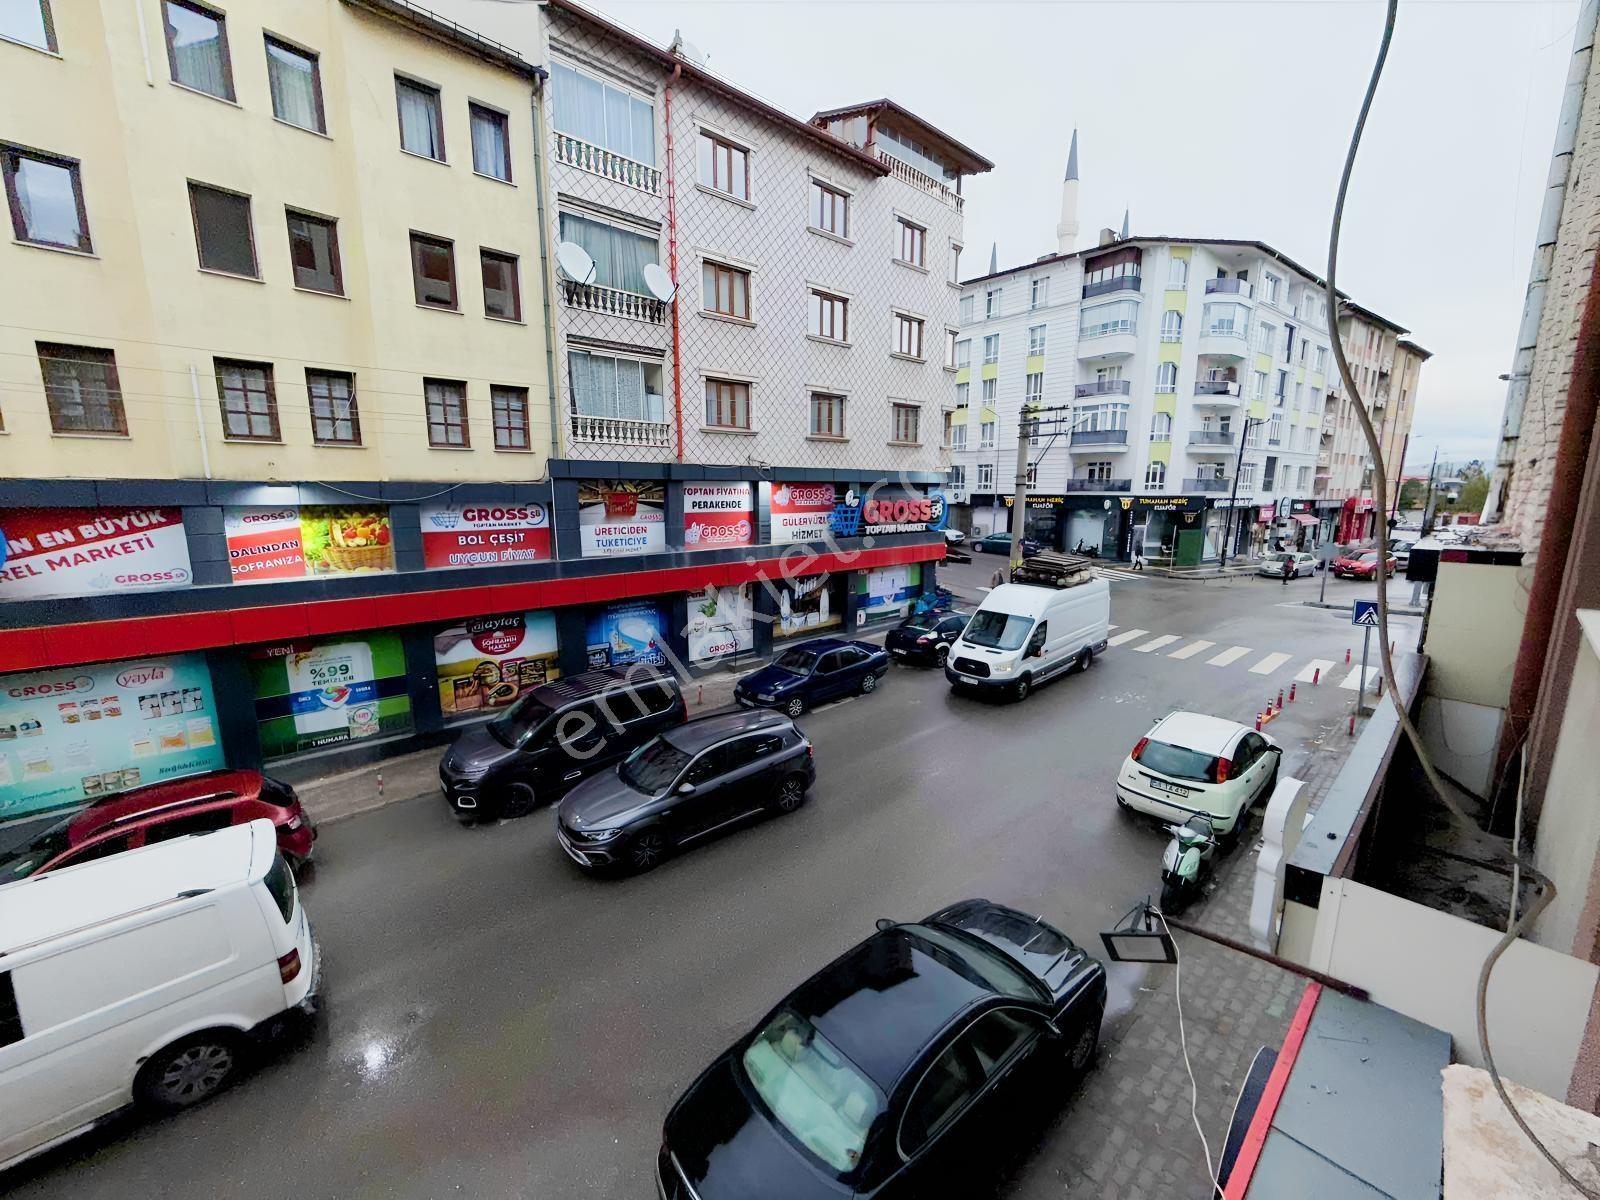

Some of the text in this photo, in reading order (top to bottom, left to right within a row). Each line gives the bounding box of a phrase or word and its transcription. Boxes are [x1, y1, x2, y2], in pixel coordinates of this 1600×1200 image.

[790, 489, 825, 500] GROSS
[692, 500, 742, 509] PERAKENDE
[863, 499, 932, 524] GROSS
[242, 511, 286, 524] GROSS
[463, 508, 529, 522] GROSS
[36, 528, 76, 549] EN
[77, 509, 167, 540] BÜYÜK
[702, 525, 740, 537] GROSS
[458, 531, 526, 546] BOL ÇEŞİT
[45, 533, 155, 571] MARKETİ
[230, 540, 300, 558] DALINDAN
[231, 555, 304, 575] SOFRANIZA
[449, 551, 498, 565] UYGUN
[114, 571, 174, 584] GROSS
[709, 641, 736, 653] GROSS
[310, 663, 350, 680] %99
[8, 680, 77, 698] GROSS
